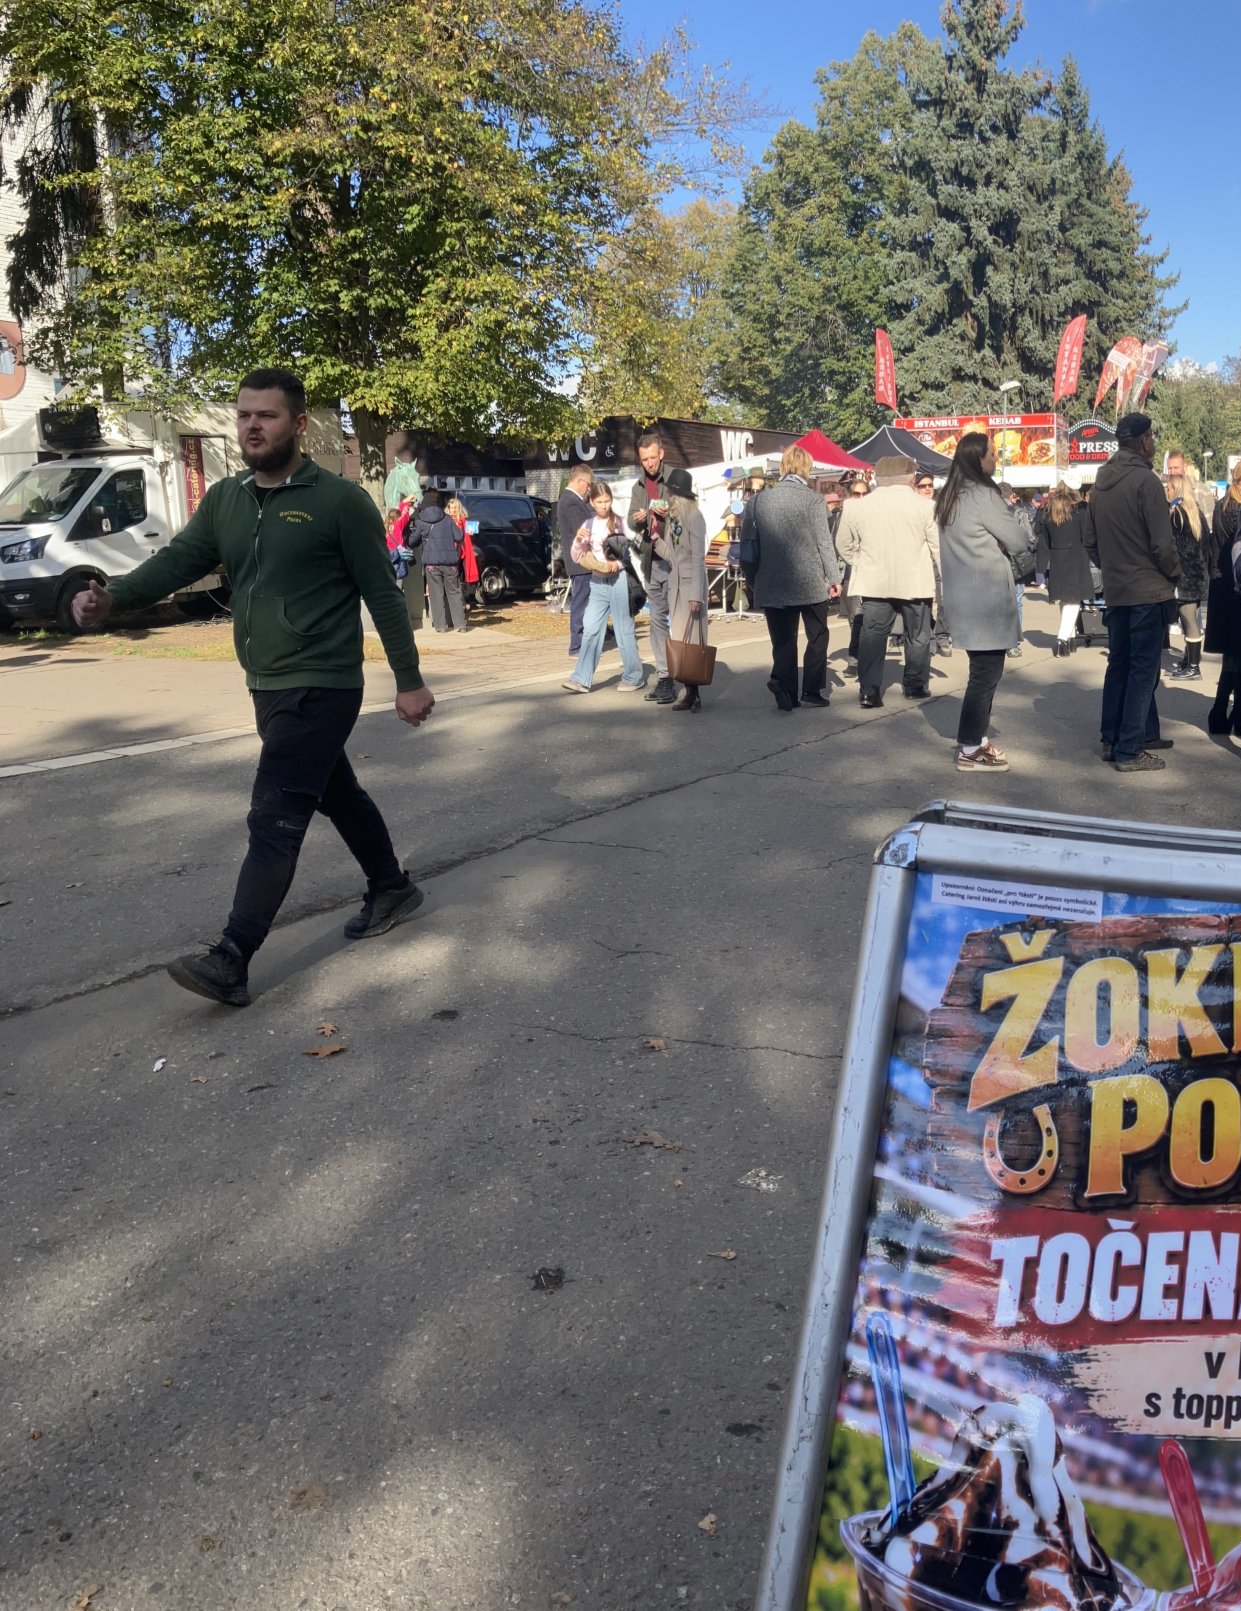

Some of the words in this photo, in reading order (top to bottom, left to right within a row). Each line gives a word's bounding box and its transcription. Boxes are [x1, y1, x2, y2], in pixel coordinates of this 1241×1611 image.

[914, 418, 960, 428] ISTANBUL
[988, 416, 1022, 426] KEBAB
[720, 429, 754, 462] WC
[941, 891, 966, 901] Catering
[1204, 1350, 1227, 1380] v
[1143, 1391, 1162, 1419] s
